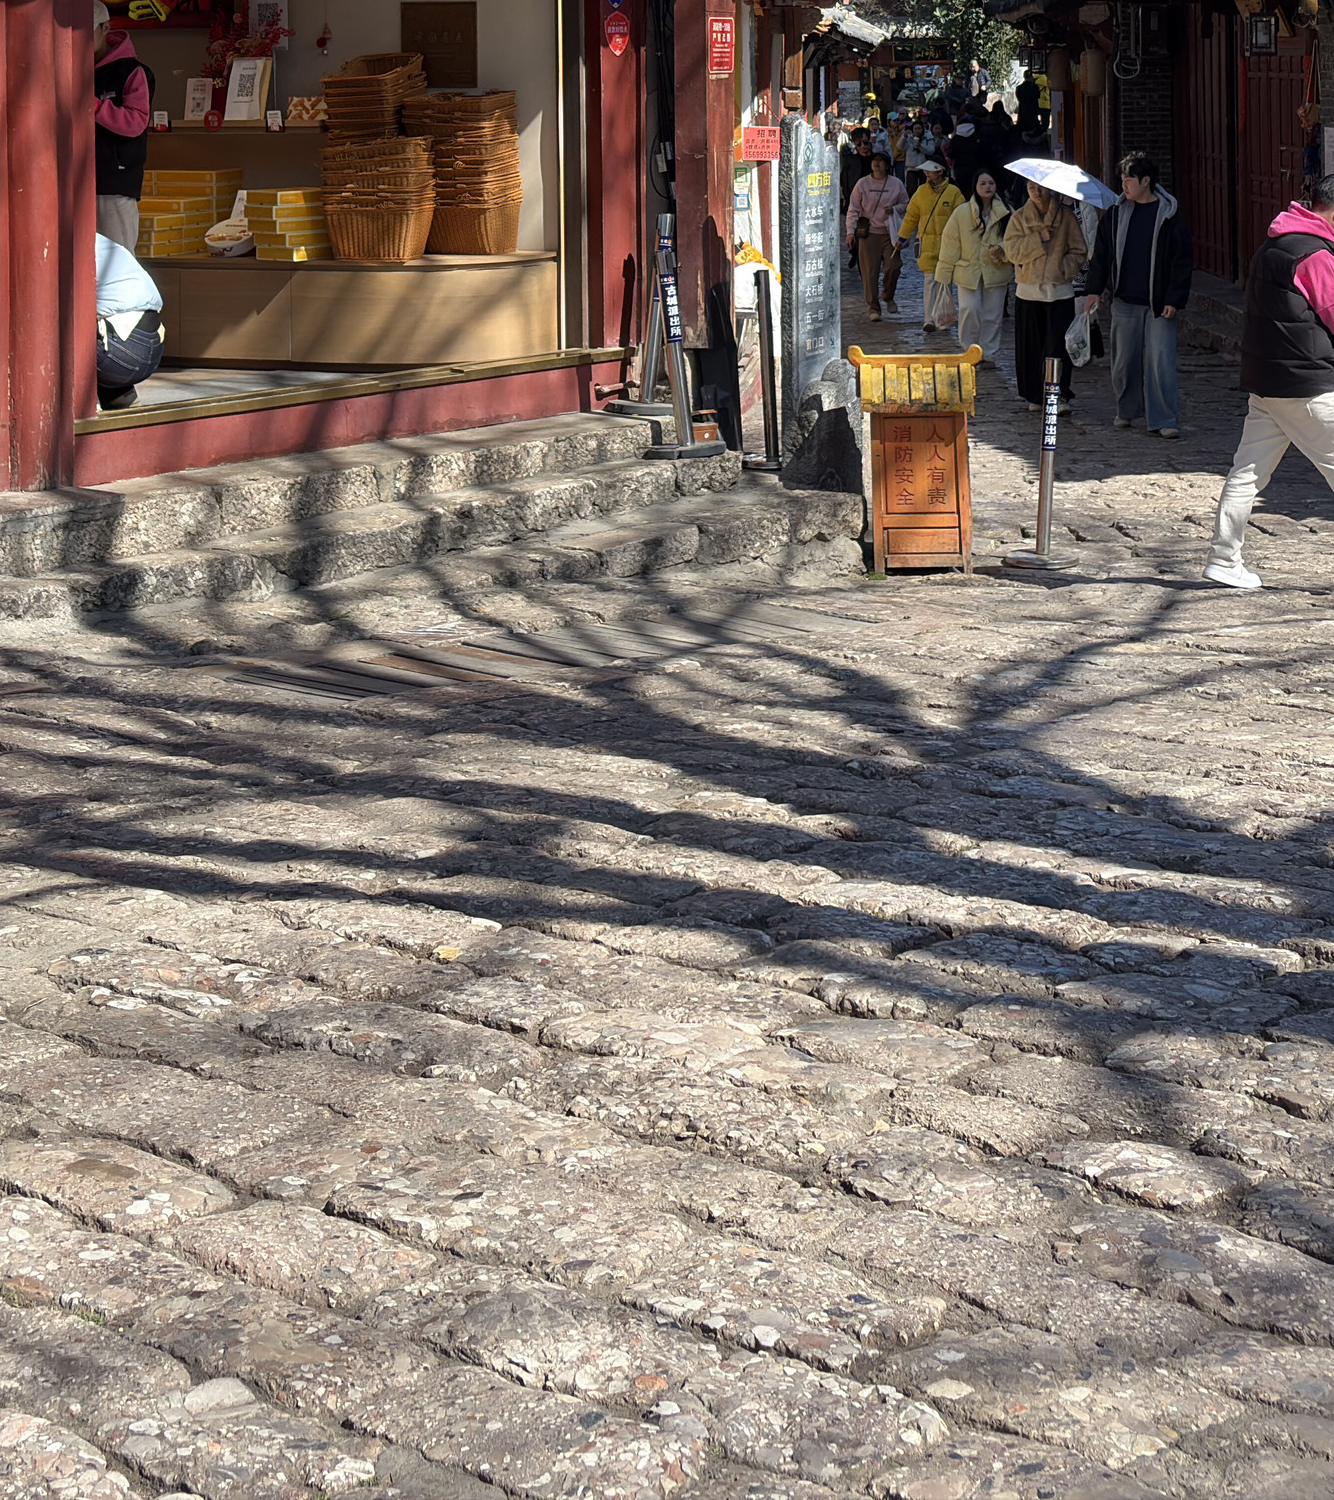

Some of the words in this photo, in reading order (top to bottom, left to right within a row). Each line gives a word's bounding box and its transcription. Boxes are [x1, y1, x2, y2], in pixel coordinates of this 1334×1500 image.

[757, 129, 777, 138] 招聘
[807, 172, 831, 188] 四方街
[805, 206, 823, 218] 大水车
[805, 258, 823, 272] 万古楼
[805, 284, 823, 297] 大石桥
[665, 284, 682, 337] 古城派出所
[1043, 393, 1058, 445] 古城派出所
[893, 425, 914, 506] 消防安全
[926, 424, 947, 506] 人人有责
